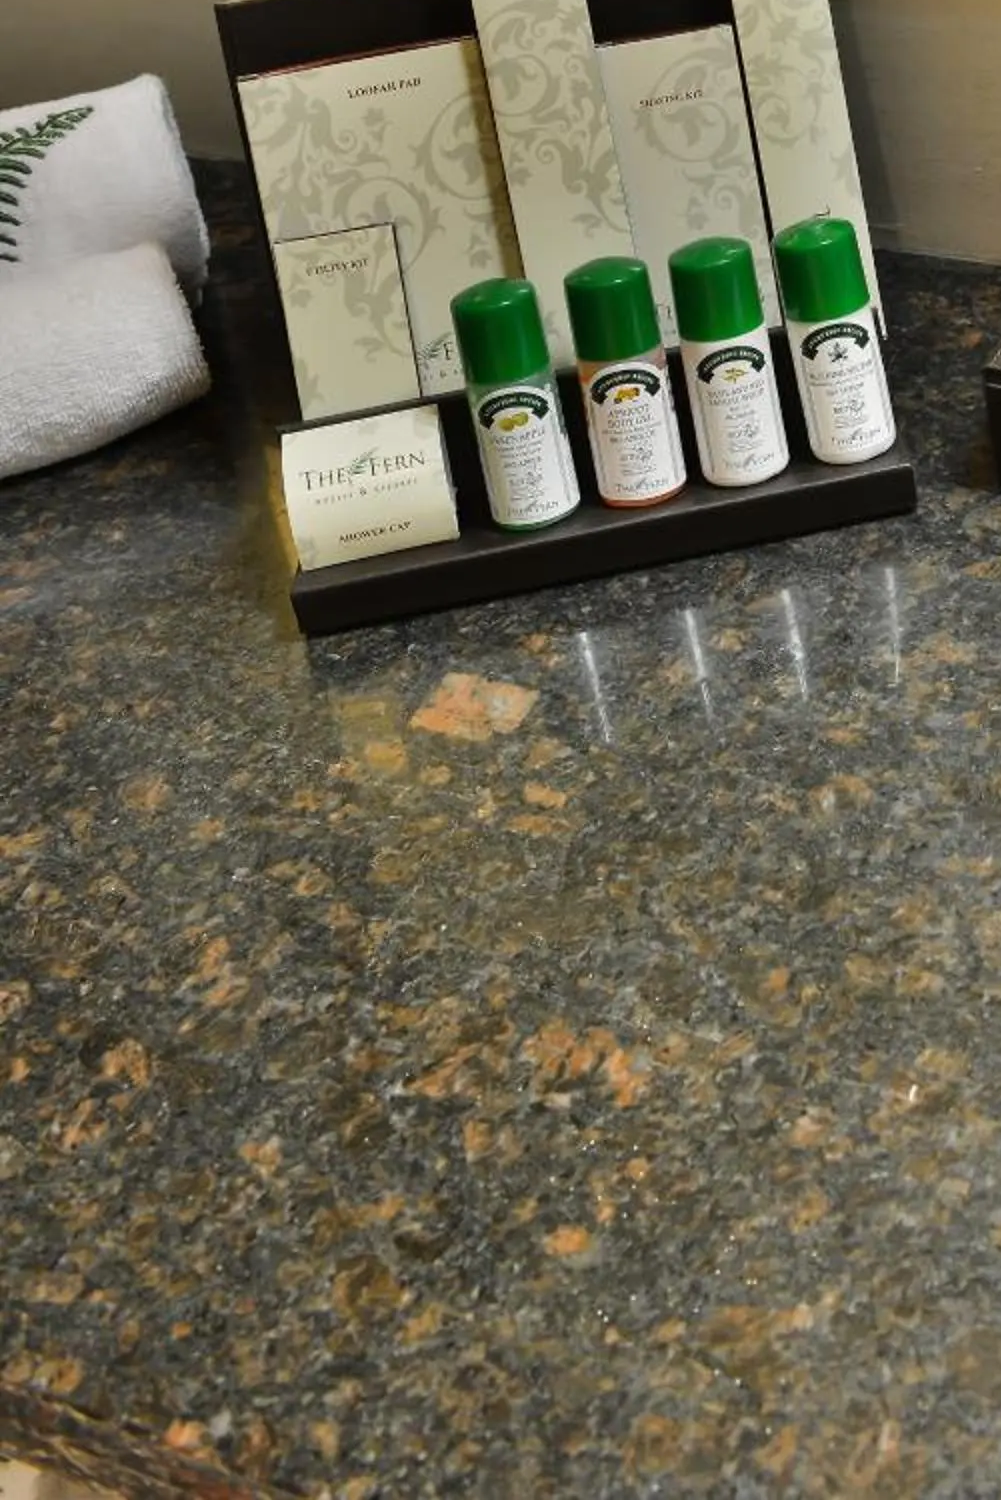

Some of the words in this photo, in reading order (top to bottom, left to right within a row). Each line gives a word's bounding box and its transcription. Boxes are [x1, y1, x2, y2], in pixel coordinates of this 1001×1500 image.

[400, 76, 422, 91] PAD
[299, 467, 349, 491] THE
[369, 451, 425, 477] FERN
[338, 527, 386, 543] SHOWER
[388, 520, 412, 534] CAP
